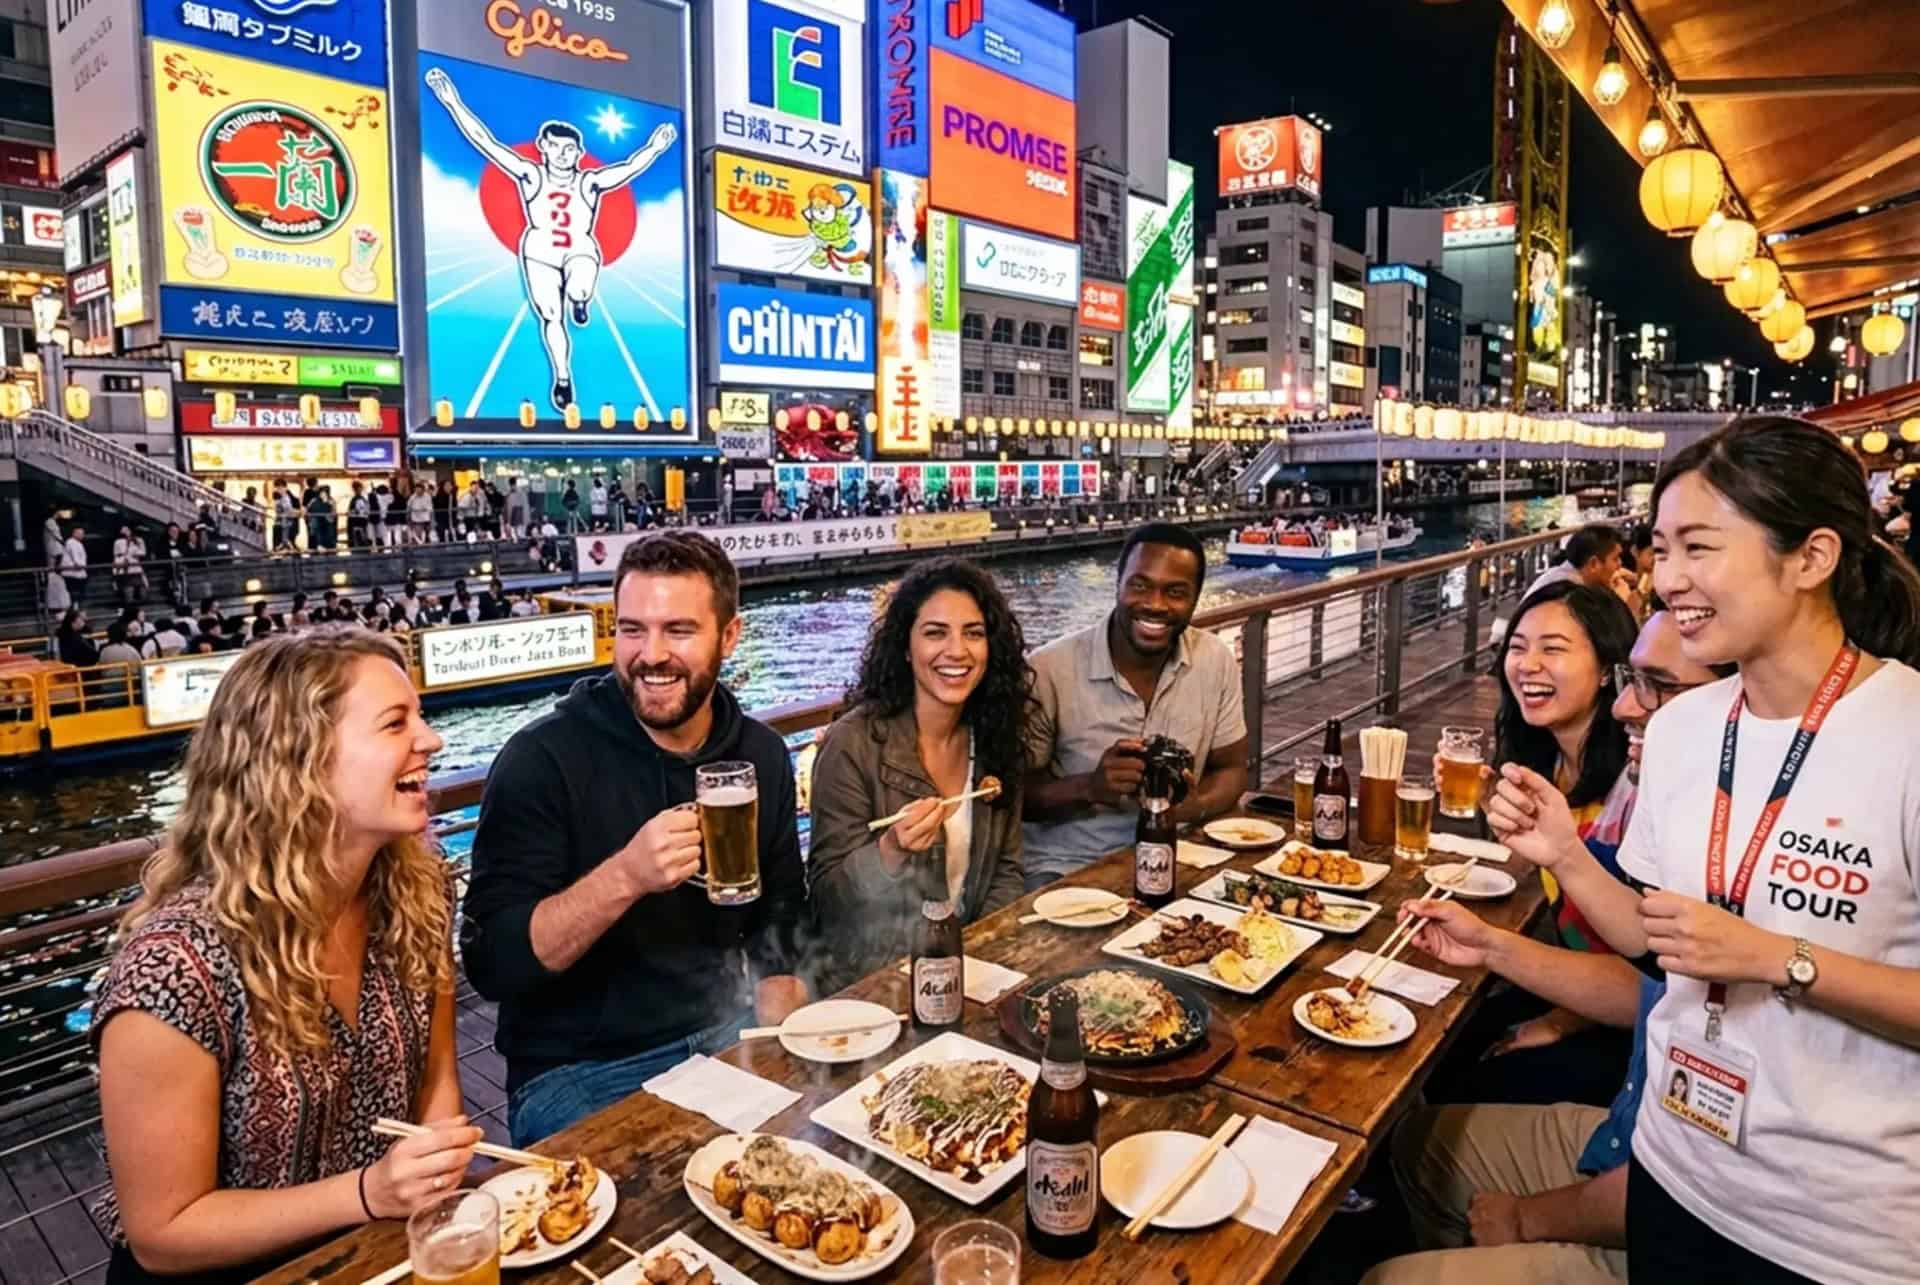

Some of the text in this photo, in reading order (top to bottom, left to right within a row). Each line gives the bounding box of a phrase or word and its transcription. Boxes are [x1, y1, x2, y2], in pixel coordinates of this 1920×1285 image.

[486, 0, 630, 59] Glico
[944, 105, 1068, 174] PROMSE
[728, 299, 865, 362] CHINTAI
[1769, 854, 1869, 895] FOOD
[1780, 831, 1873, 868] OSAKA
[1768, 882, 1858, 923] TOUR
